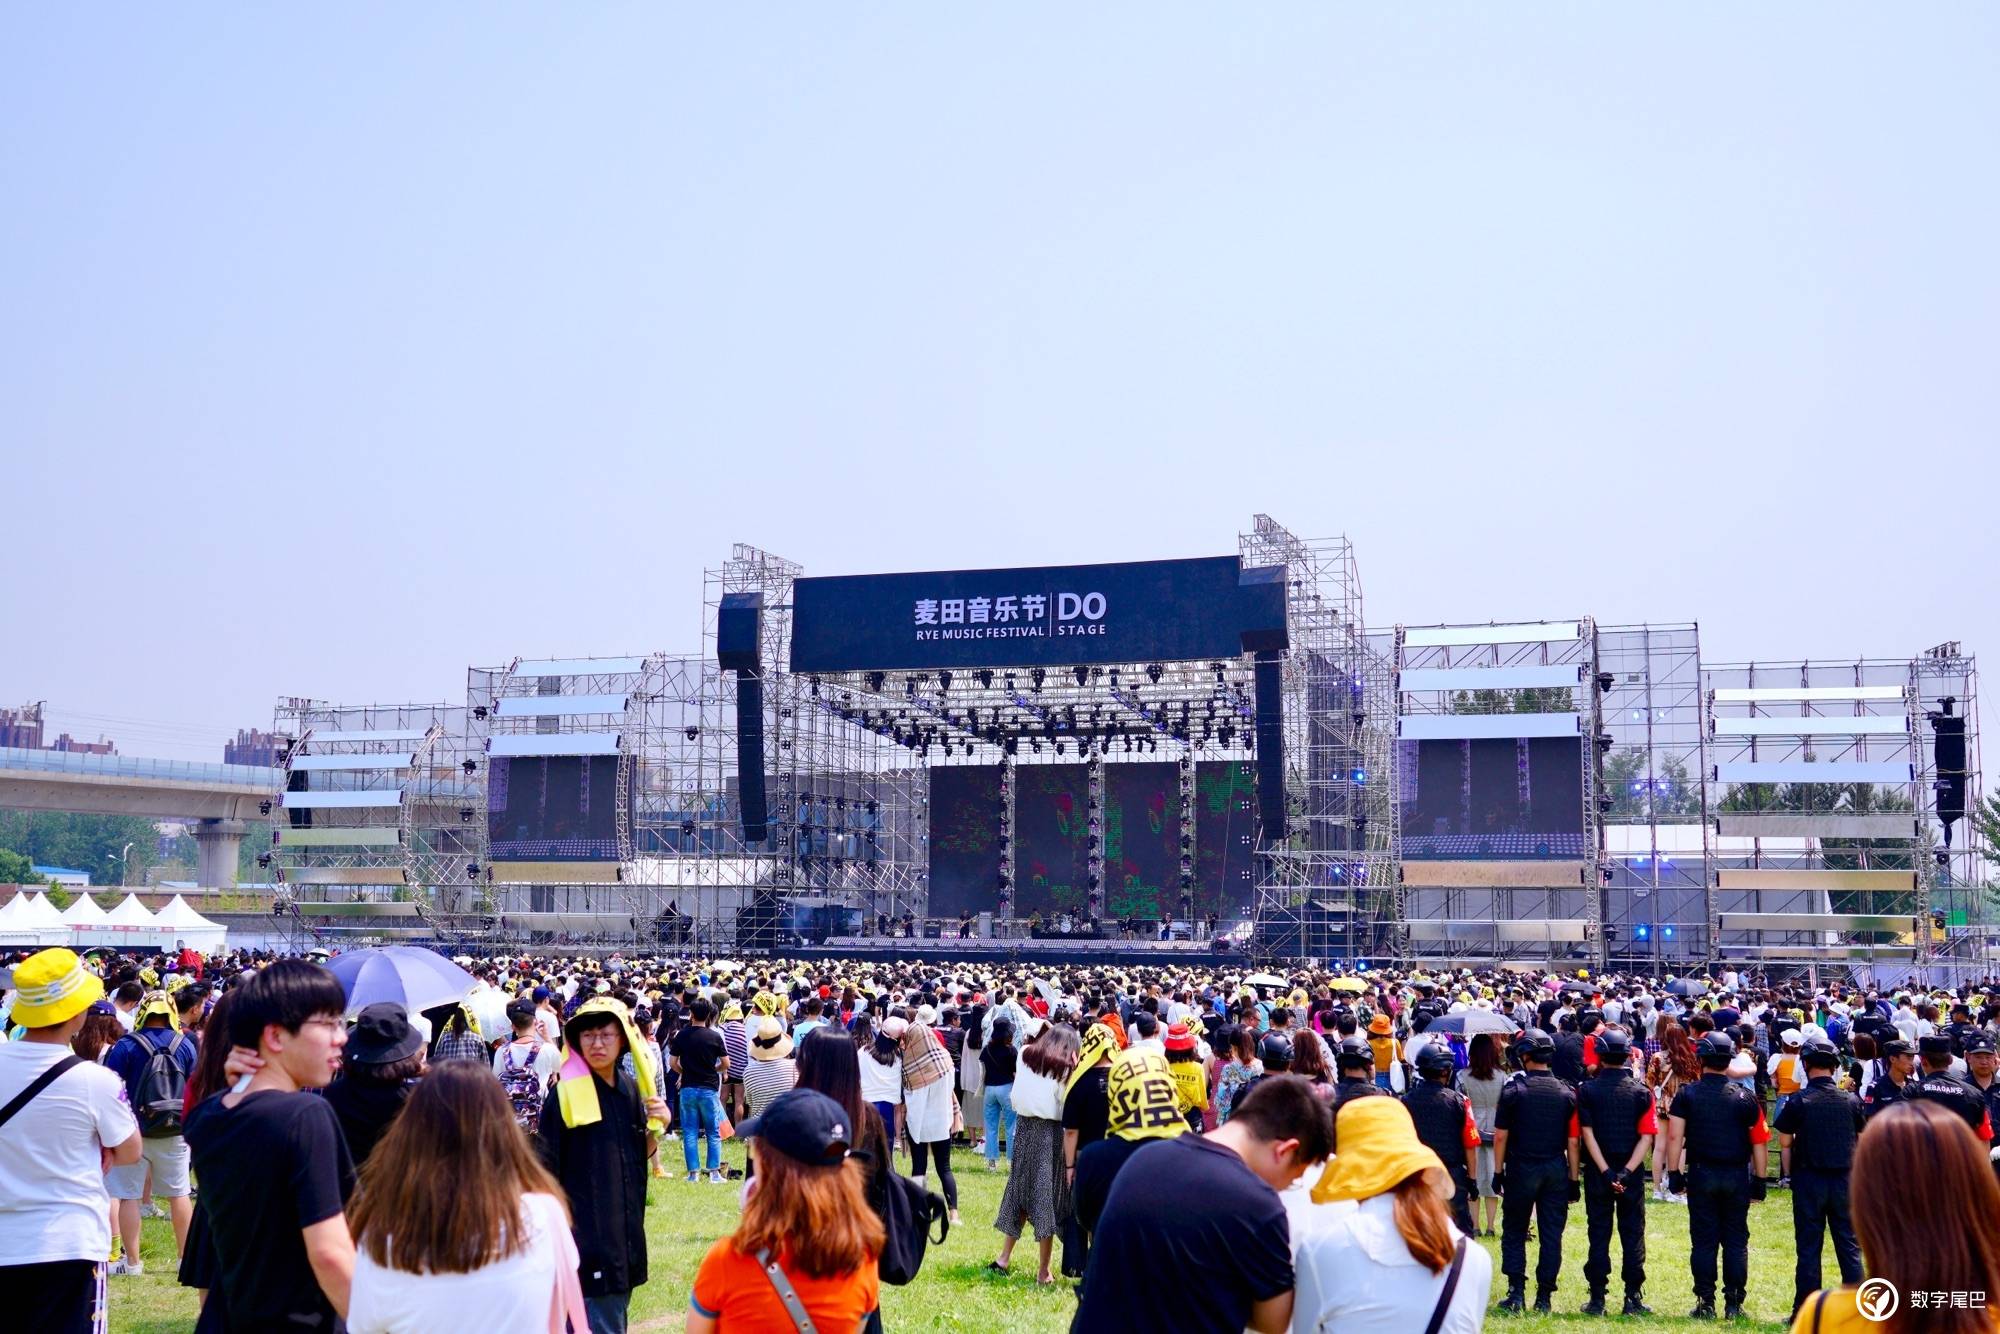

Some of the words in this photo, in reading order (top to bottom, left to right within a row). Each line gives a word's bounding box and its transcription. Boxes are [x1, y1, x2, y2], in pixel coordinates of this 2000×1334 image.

[914, 594, 1047, 625] 麦田音乐节
[1058, 592, 1107, 621] DO
[916, 629, 939, 641] RYE
[942, 628, 983, 640] MUSIC
[986, 626, 1045, 638] FESTIVAL
[1058, 624, 1106, 636] STAGE
